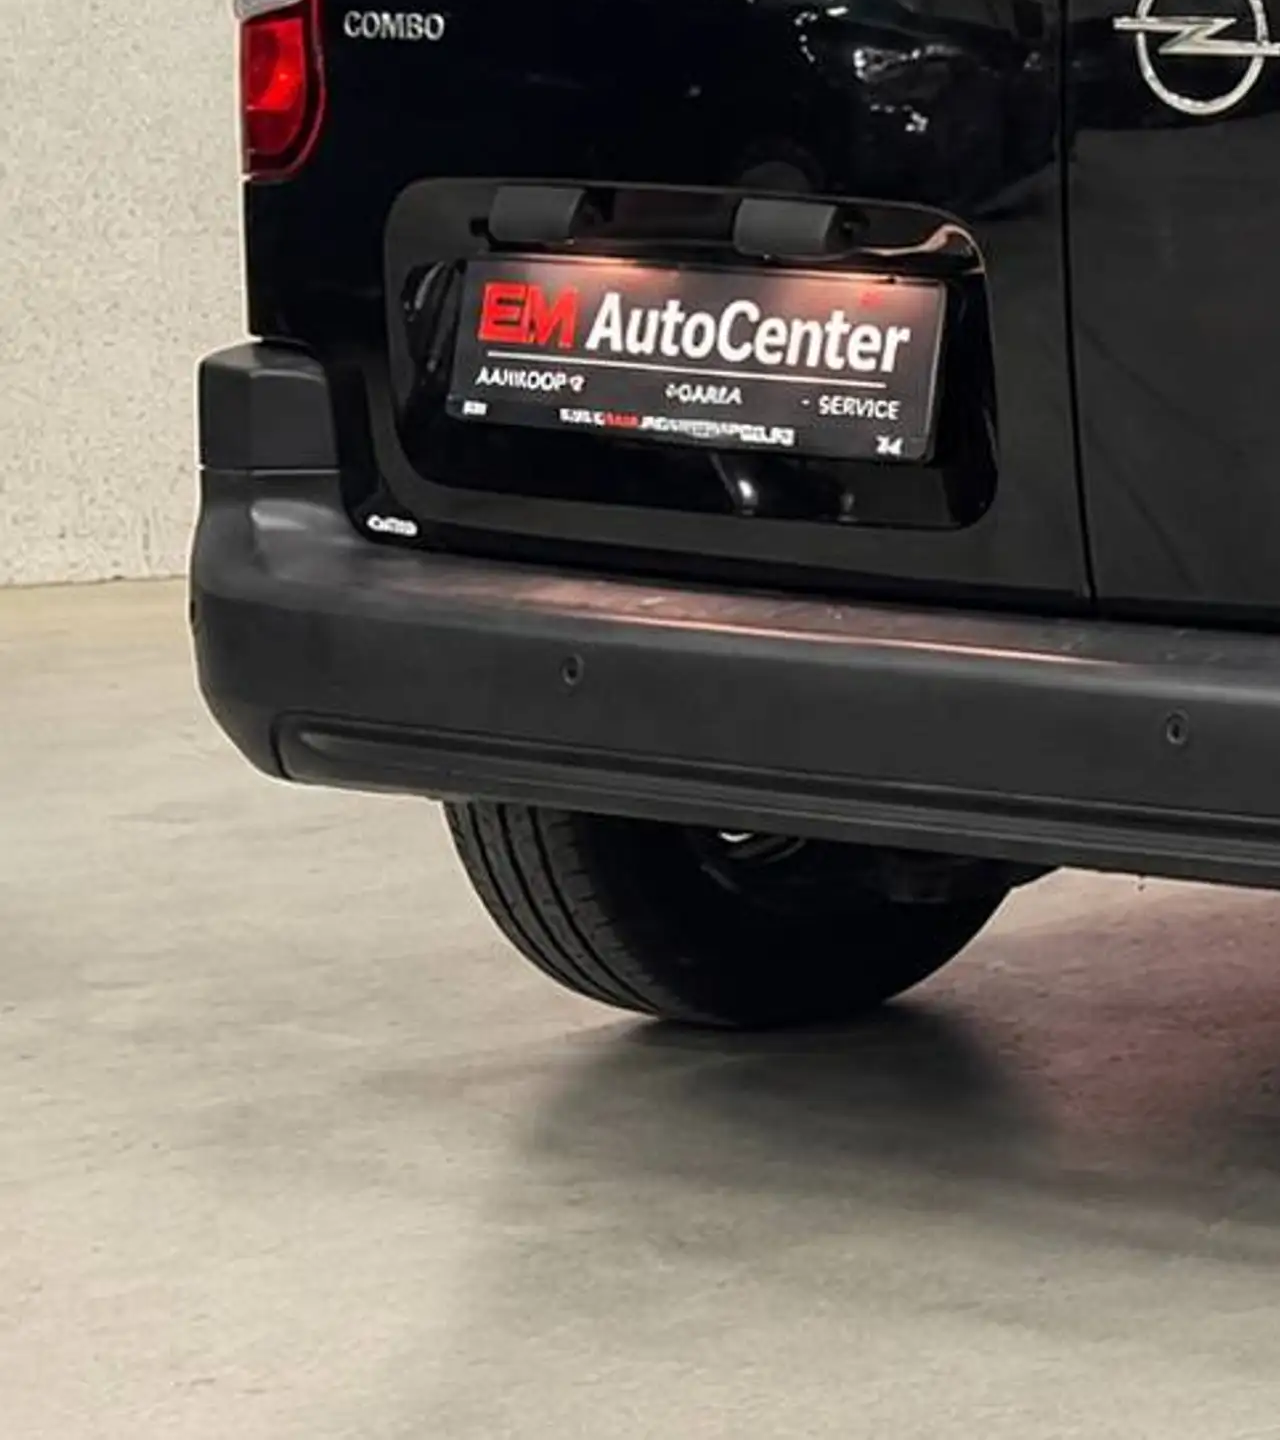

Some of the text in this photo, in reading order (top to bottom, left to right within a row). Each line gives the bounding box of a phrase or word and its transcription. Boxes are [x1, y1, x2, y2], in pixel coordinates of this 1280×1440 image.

[343, 9, 446, 41] COMBO
[478, 281, 911, 373] EM AutoCenter
[818, 394, 900, 421] SERVICE
